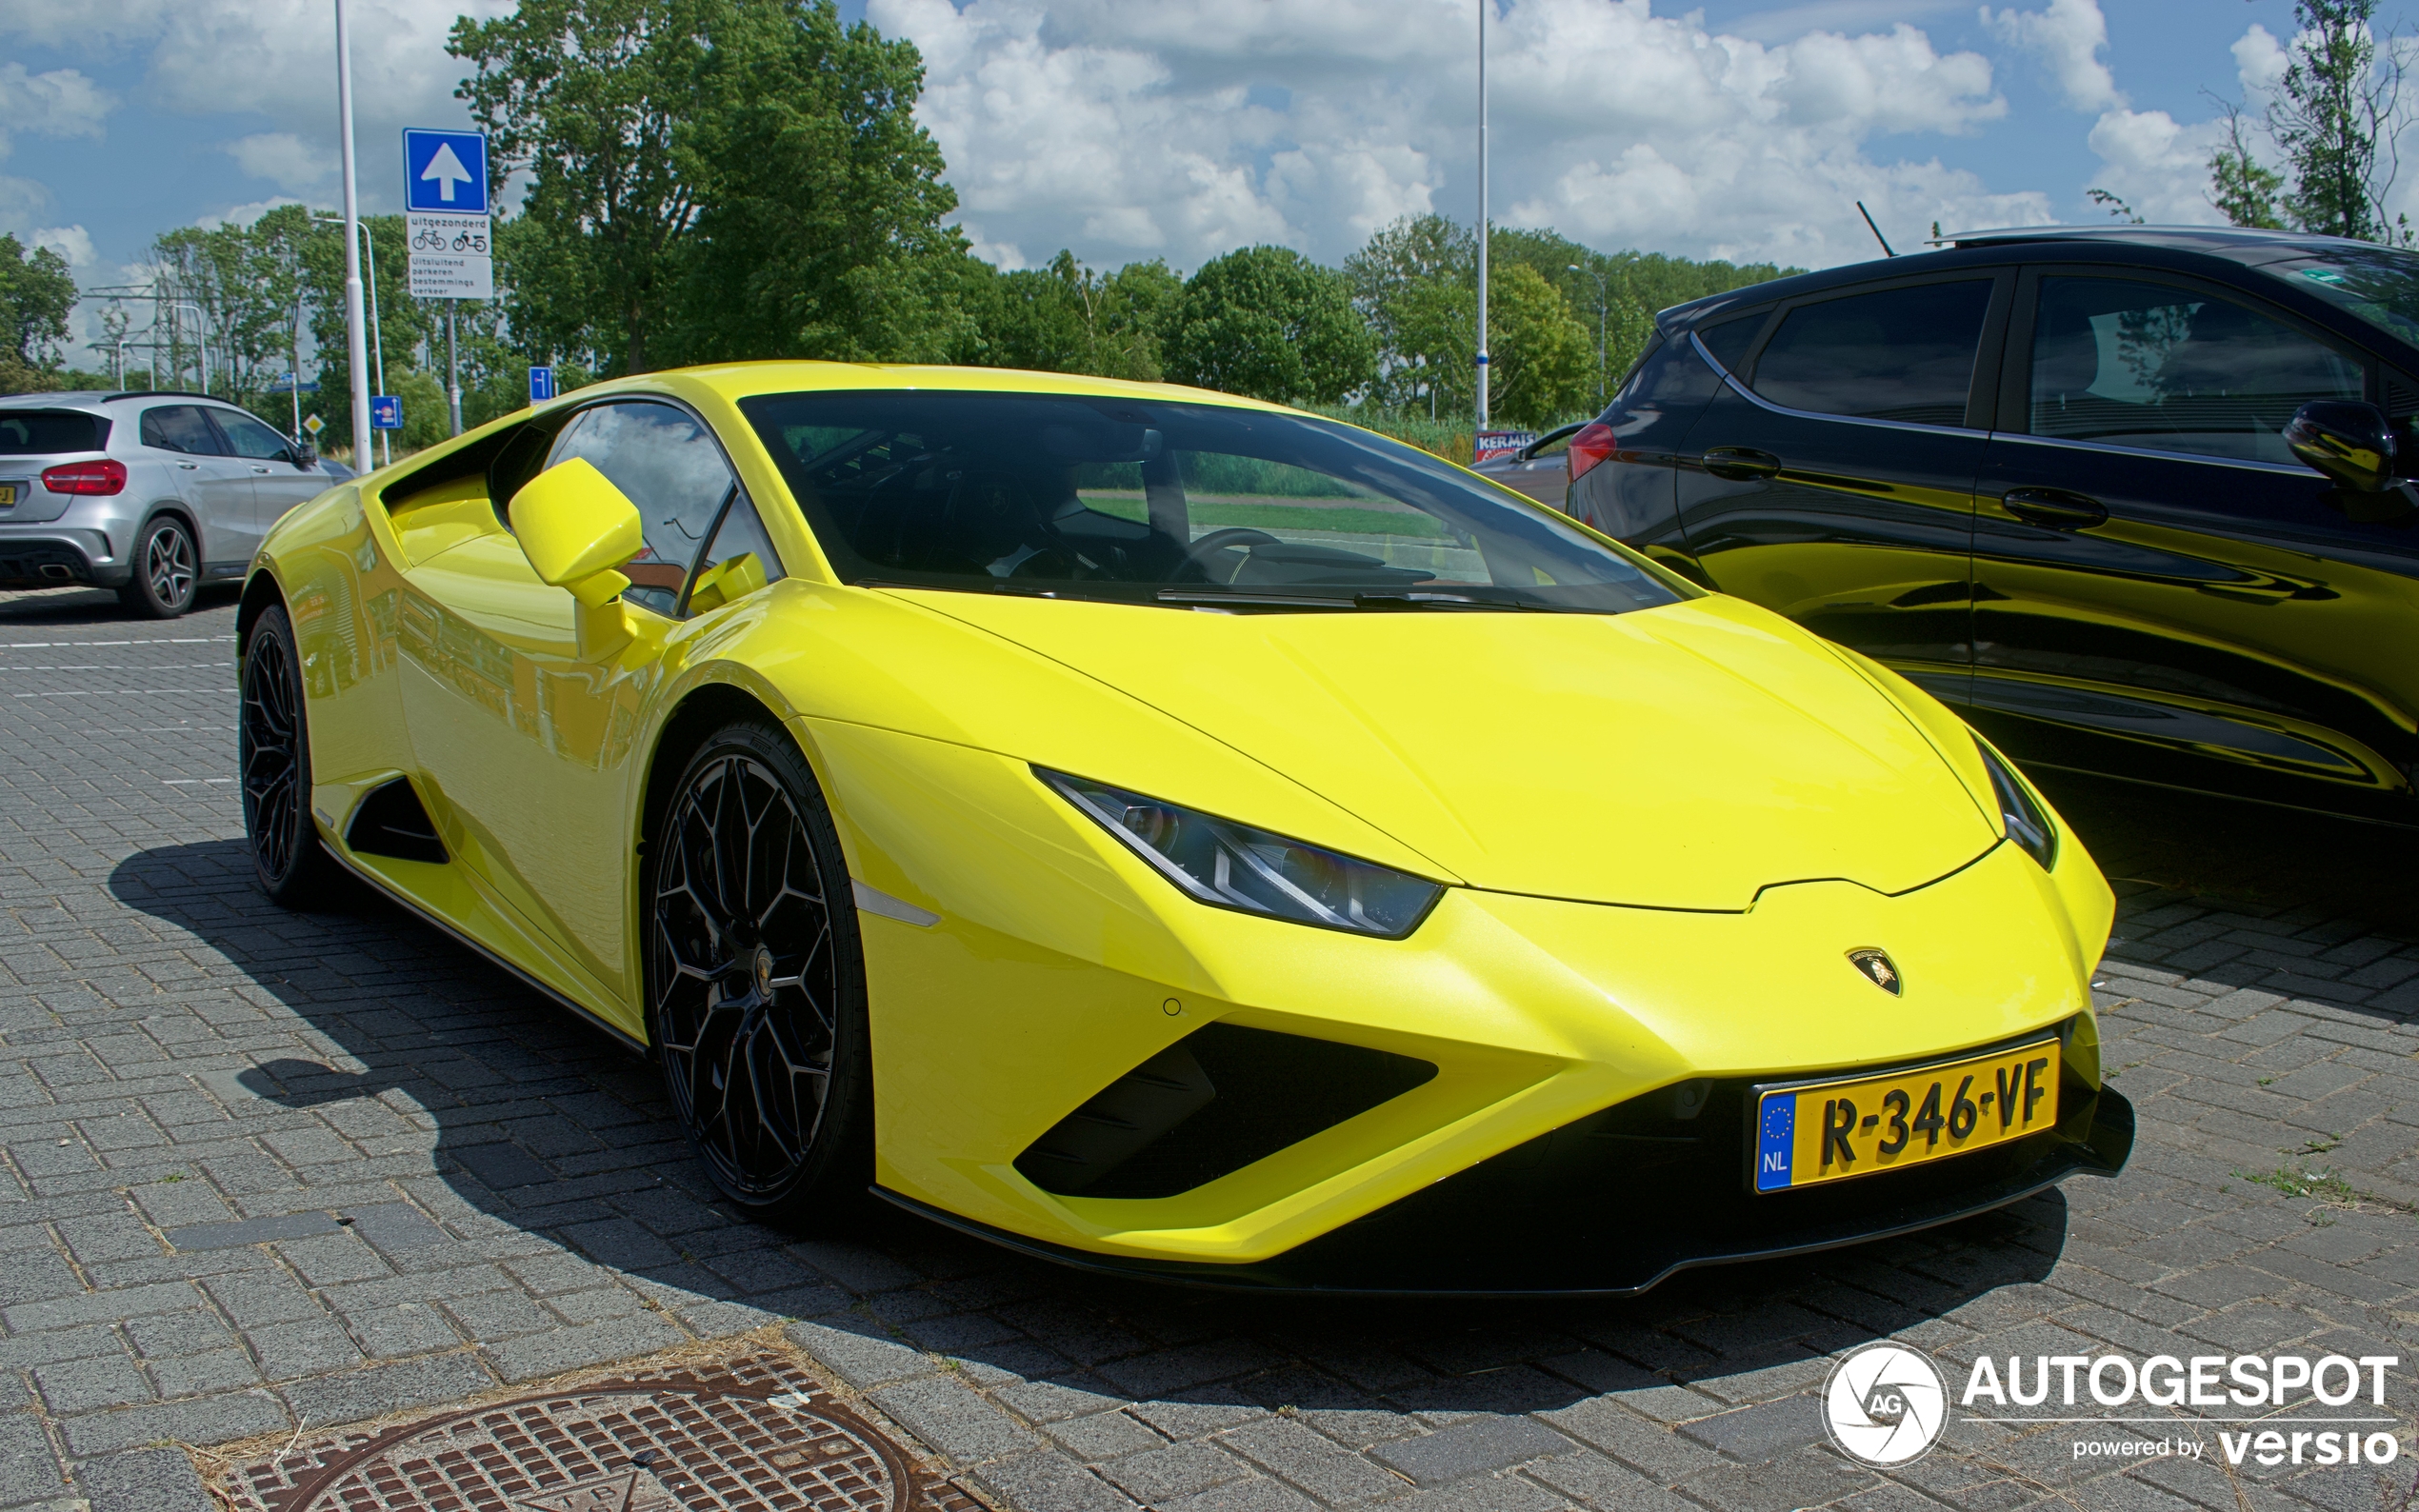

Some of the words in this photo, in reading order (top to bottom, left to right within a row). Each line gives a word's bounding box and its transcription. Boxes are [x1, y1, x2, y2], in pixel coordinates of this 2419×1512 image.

[411, 217, 486, 229] uitgezonderd
[412, 258, 465, 267] Uitsluitend
[412, 277, 474, 288] bestemmings
[412, 287, 449, 295] verkeer
[1479, 434, 1534, 449] KERMIS
[1822, 1057, 2049, 1166] R-346-VF
[1763, 1150, 1788, 1174] NL
